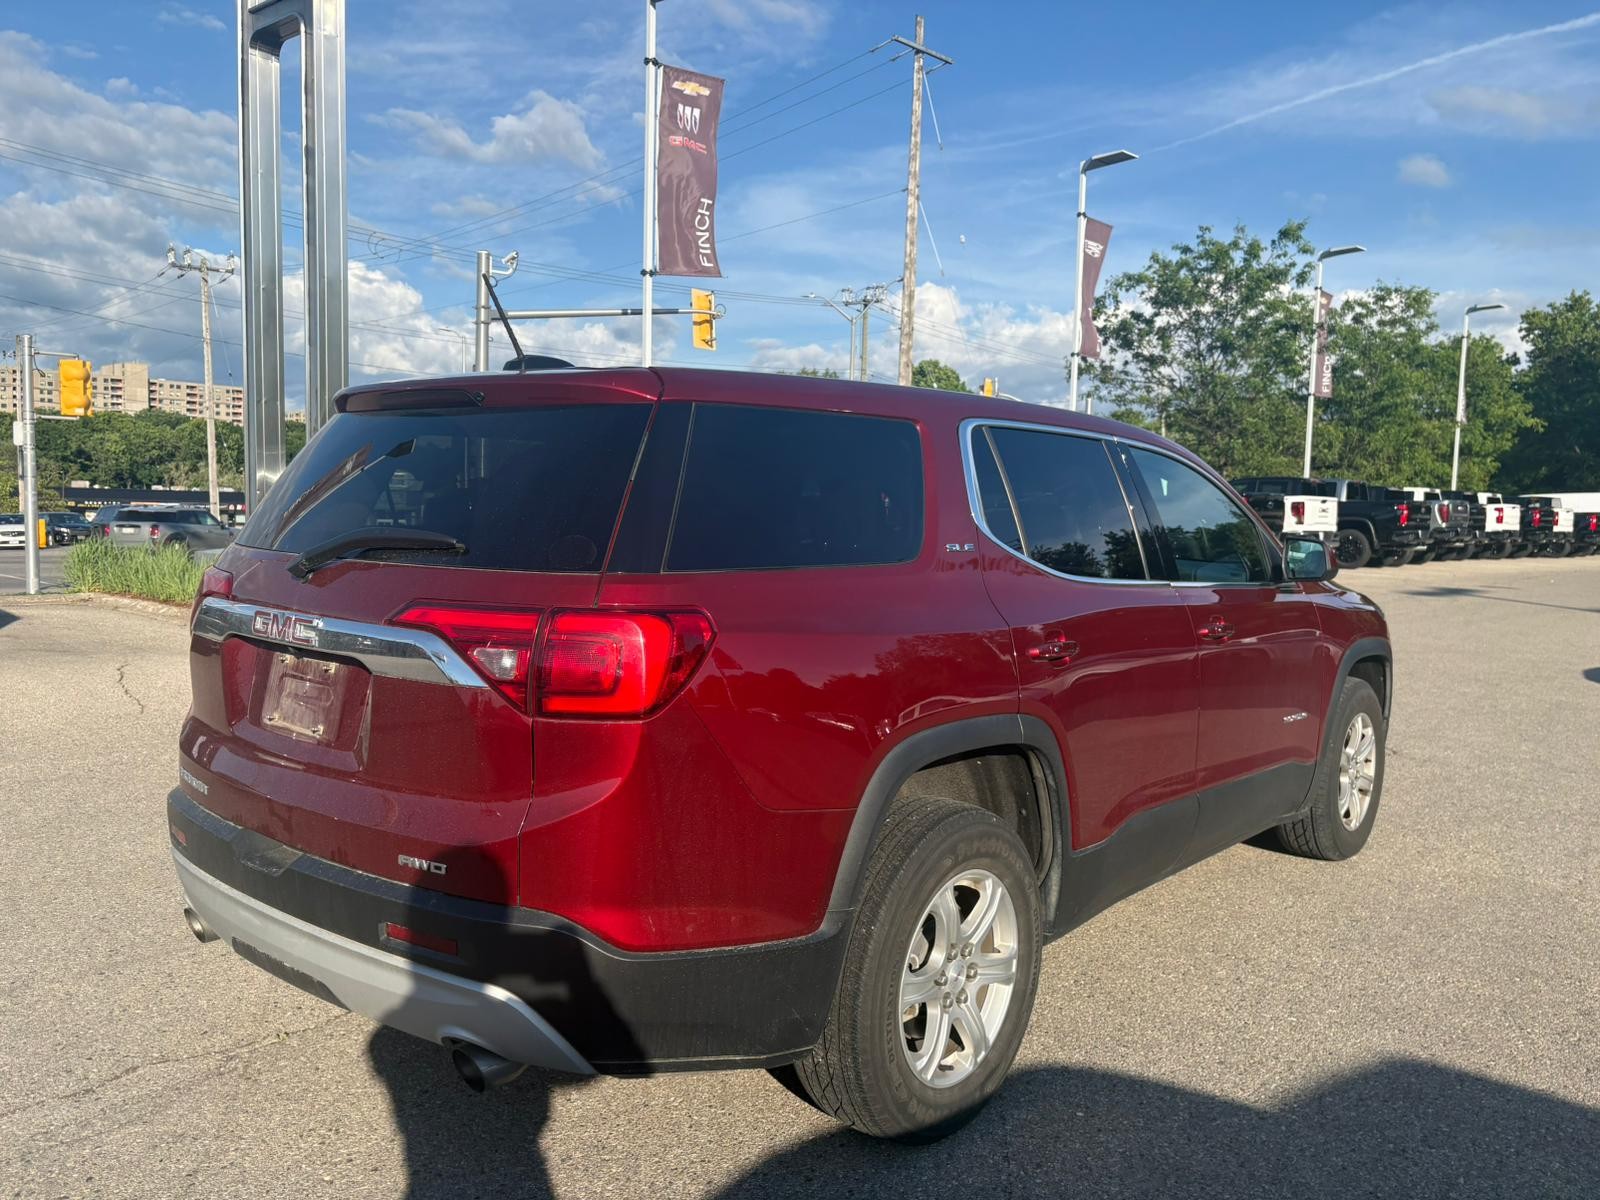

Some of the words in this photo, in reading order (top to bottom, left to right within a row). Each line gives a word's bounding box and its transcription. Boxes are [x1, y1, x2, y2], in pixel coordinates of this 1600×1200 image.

[669, 135, 707, 155] GMC
[695, 198, 713, 267] FINCH
[945, 543, 975, 552] SLE
[252, 610, 323, 647] GMC
[397, 854, 447, 875] AWD
